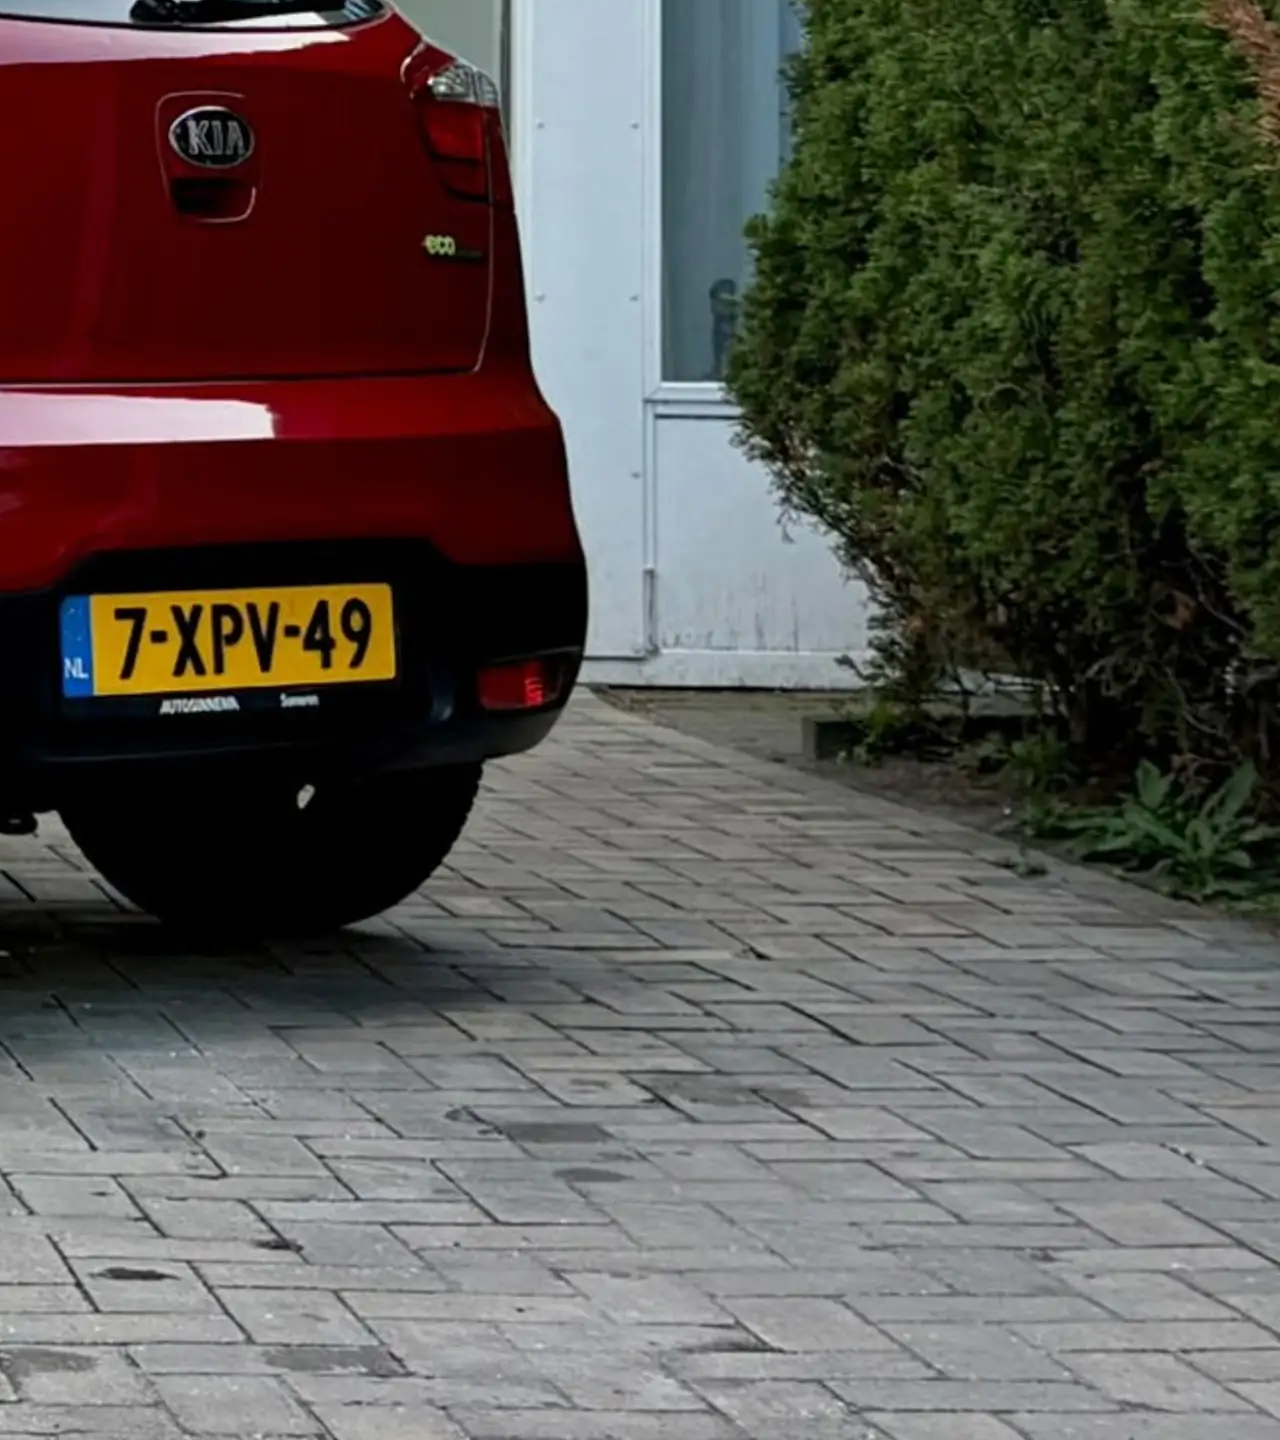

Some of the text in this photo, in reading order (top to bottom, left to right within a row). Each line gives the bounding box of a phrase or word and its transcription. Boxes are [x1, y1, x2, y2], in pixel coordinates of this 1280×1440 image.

[192, 123, 246, 156] KIA
[64, 597, 372, 680] NL 7-XPV-49
